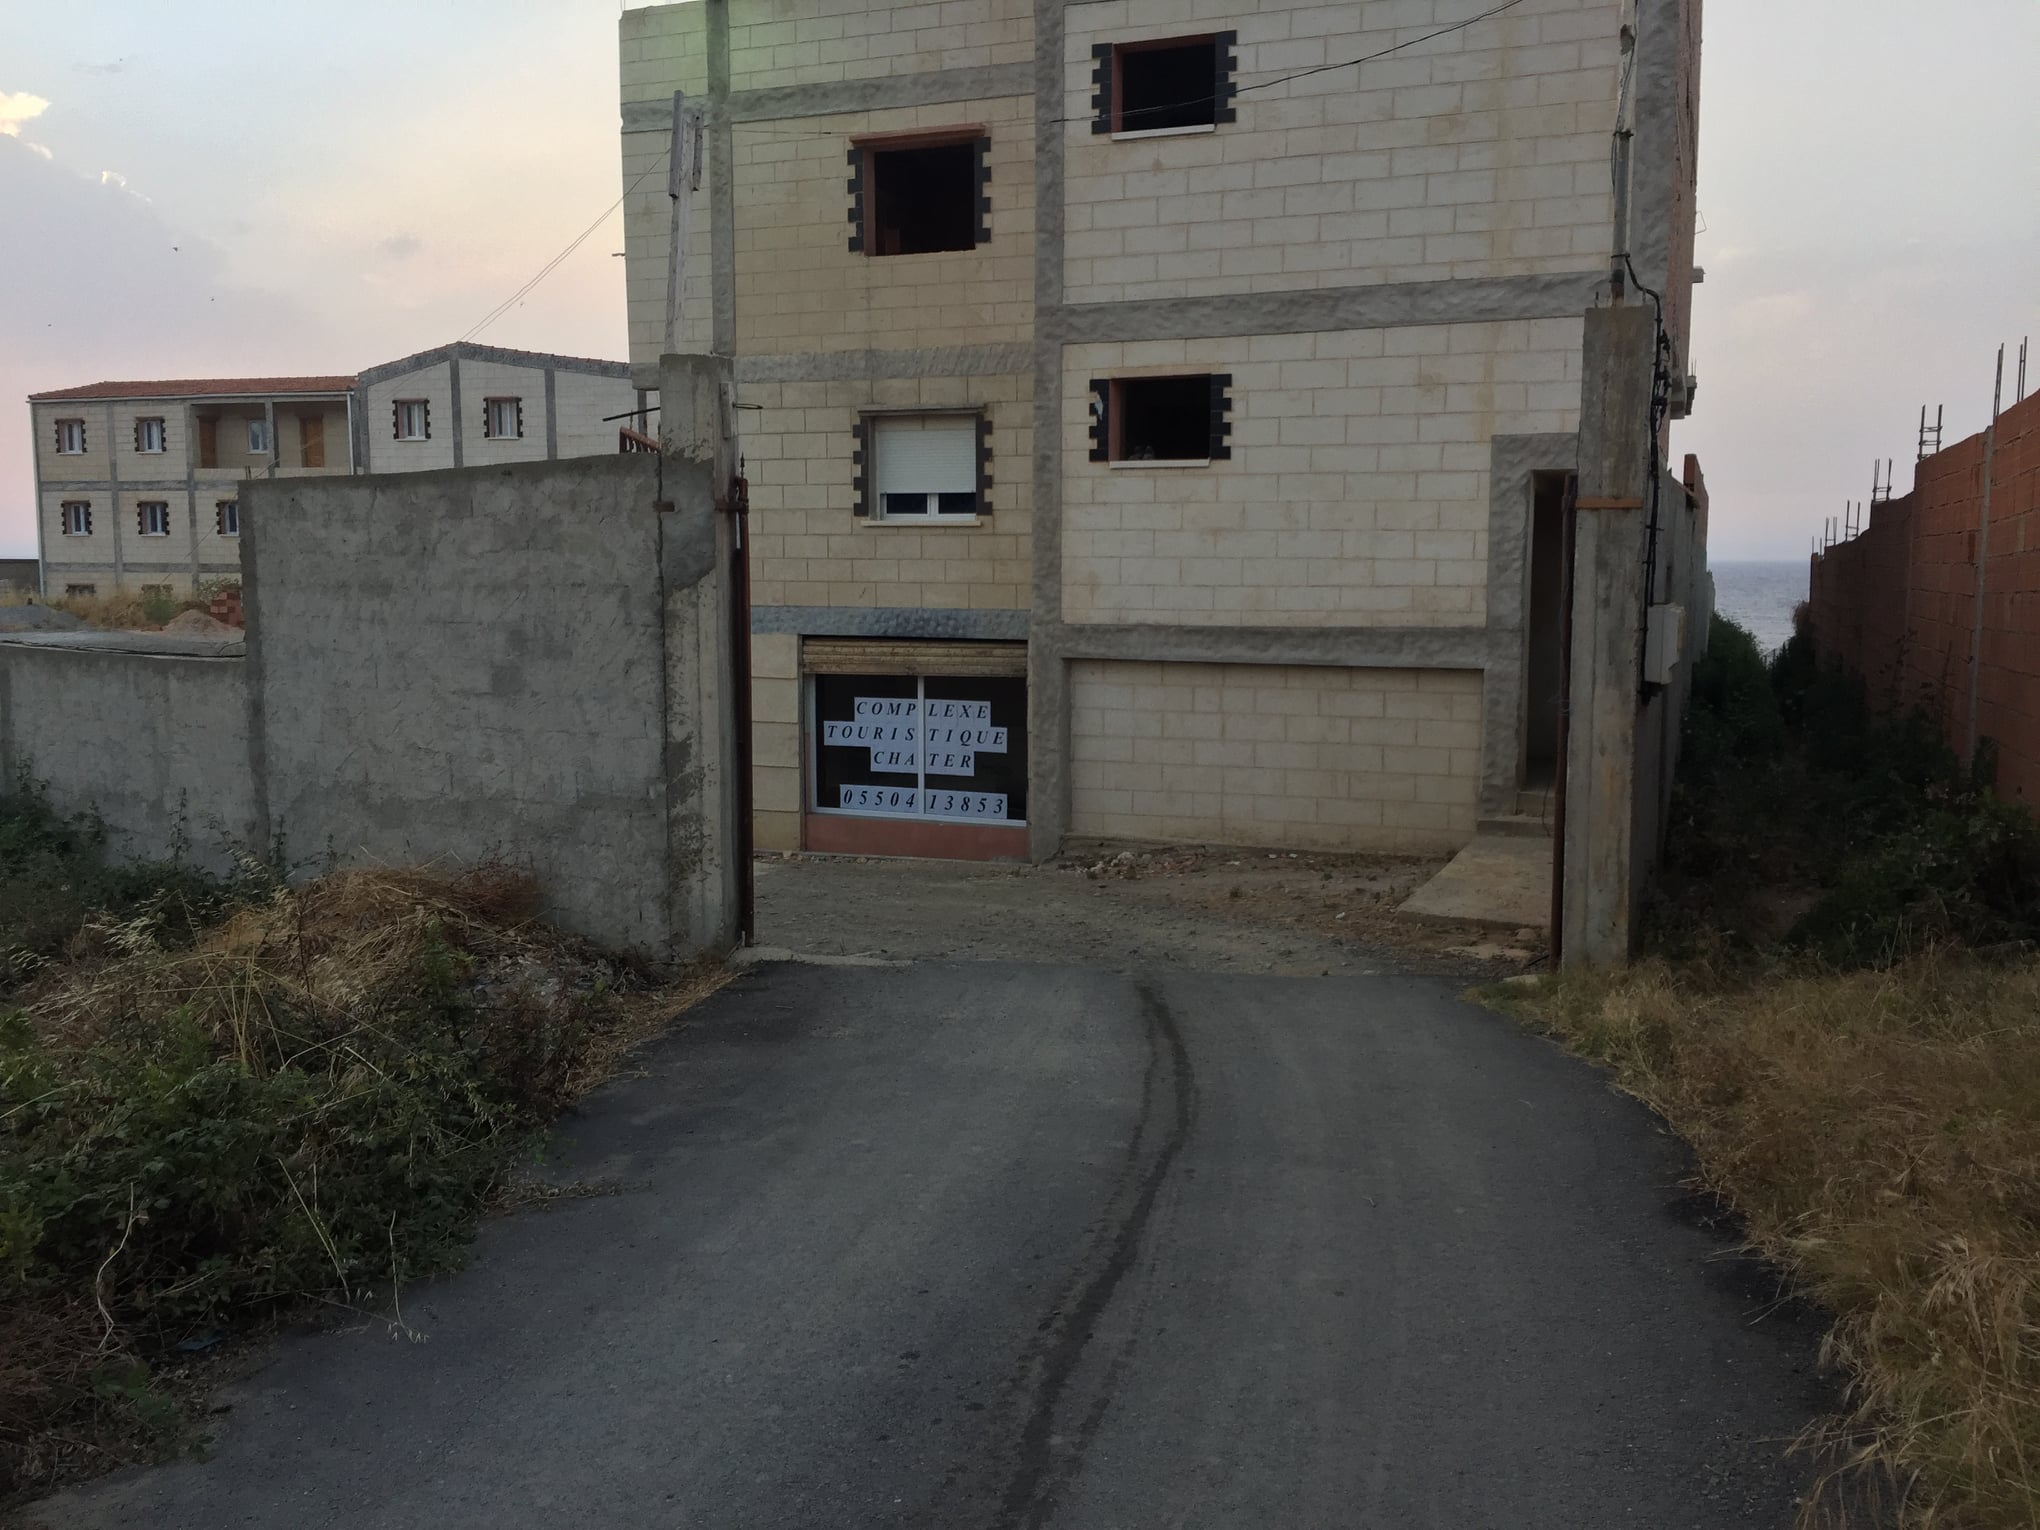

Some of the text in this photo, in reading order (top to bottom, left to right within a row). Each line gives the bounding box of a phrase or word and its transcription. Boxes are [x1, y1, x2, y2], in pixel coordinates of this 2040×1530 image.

[856, 701, 989, 719] COMPLEXE
[827, 724, 1005, 747] TOURISTIQUE
[873, 750, 972, 769] CHATER
[843, 788, 1004, 814] 0550413853
